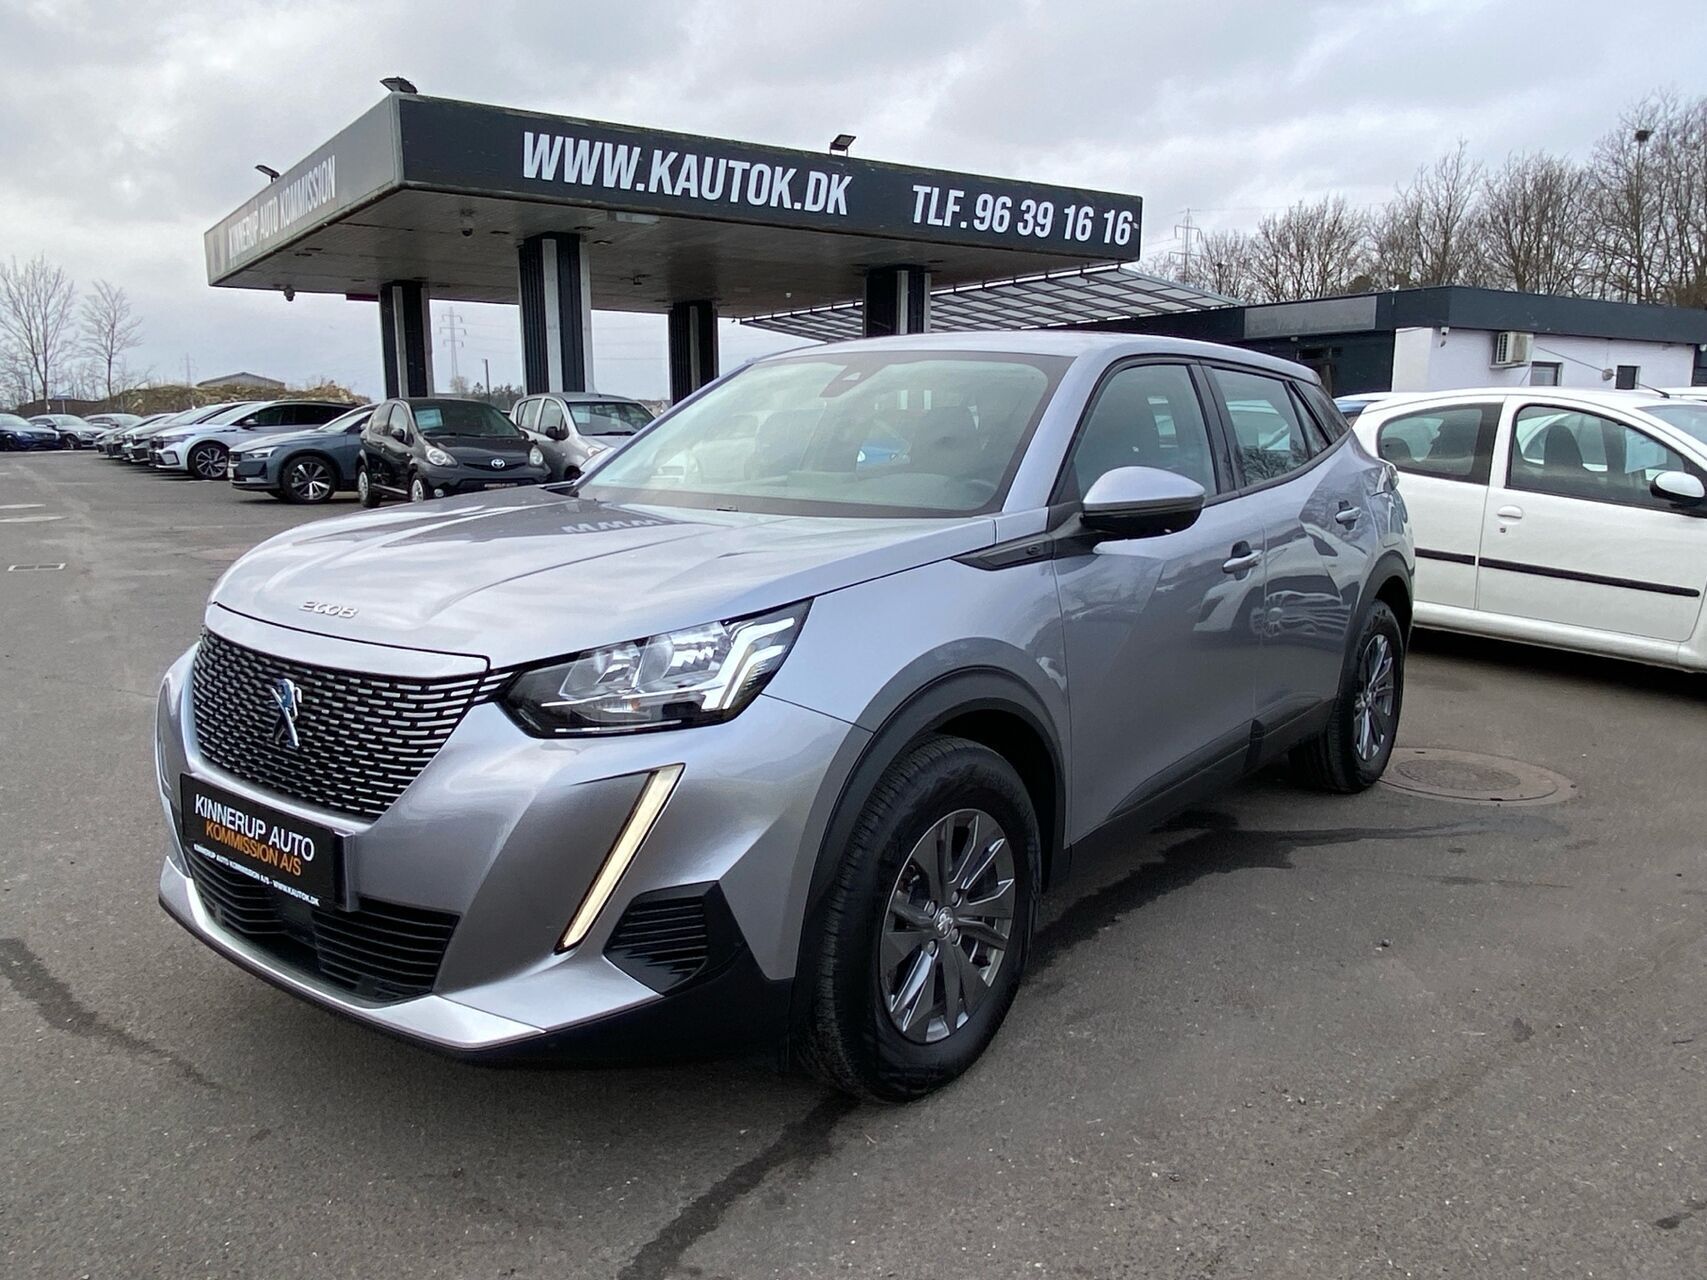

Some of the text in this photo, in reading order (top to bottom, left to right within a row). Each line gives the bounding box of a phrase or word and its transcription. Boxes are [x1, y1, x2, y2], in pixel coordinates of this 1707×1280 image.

[280, 154, 336, 230] KOMMISSION
[523, 131, 853, 216] WWW.KAUTOK.DK
[912, 184, 1133, 246] TLF. 96 39 16 16
[195, 793, 315, 862] KINNERUP AUTO
[205, 820, 302, 876] KOMMISSION A/S
